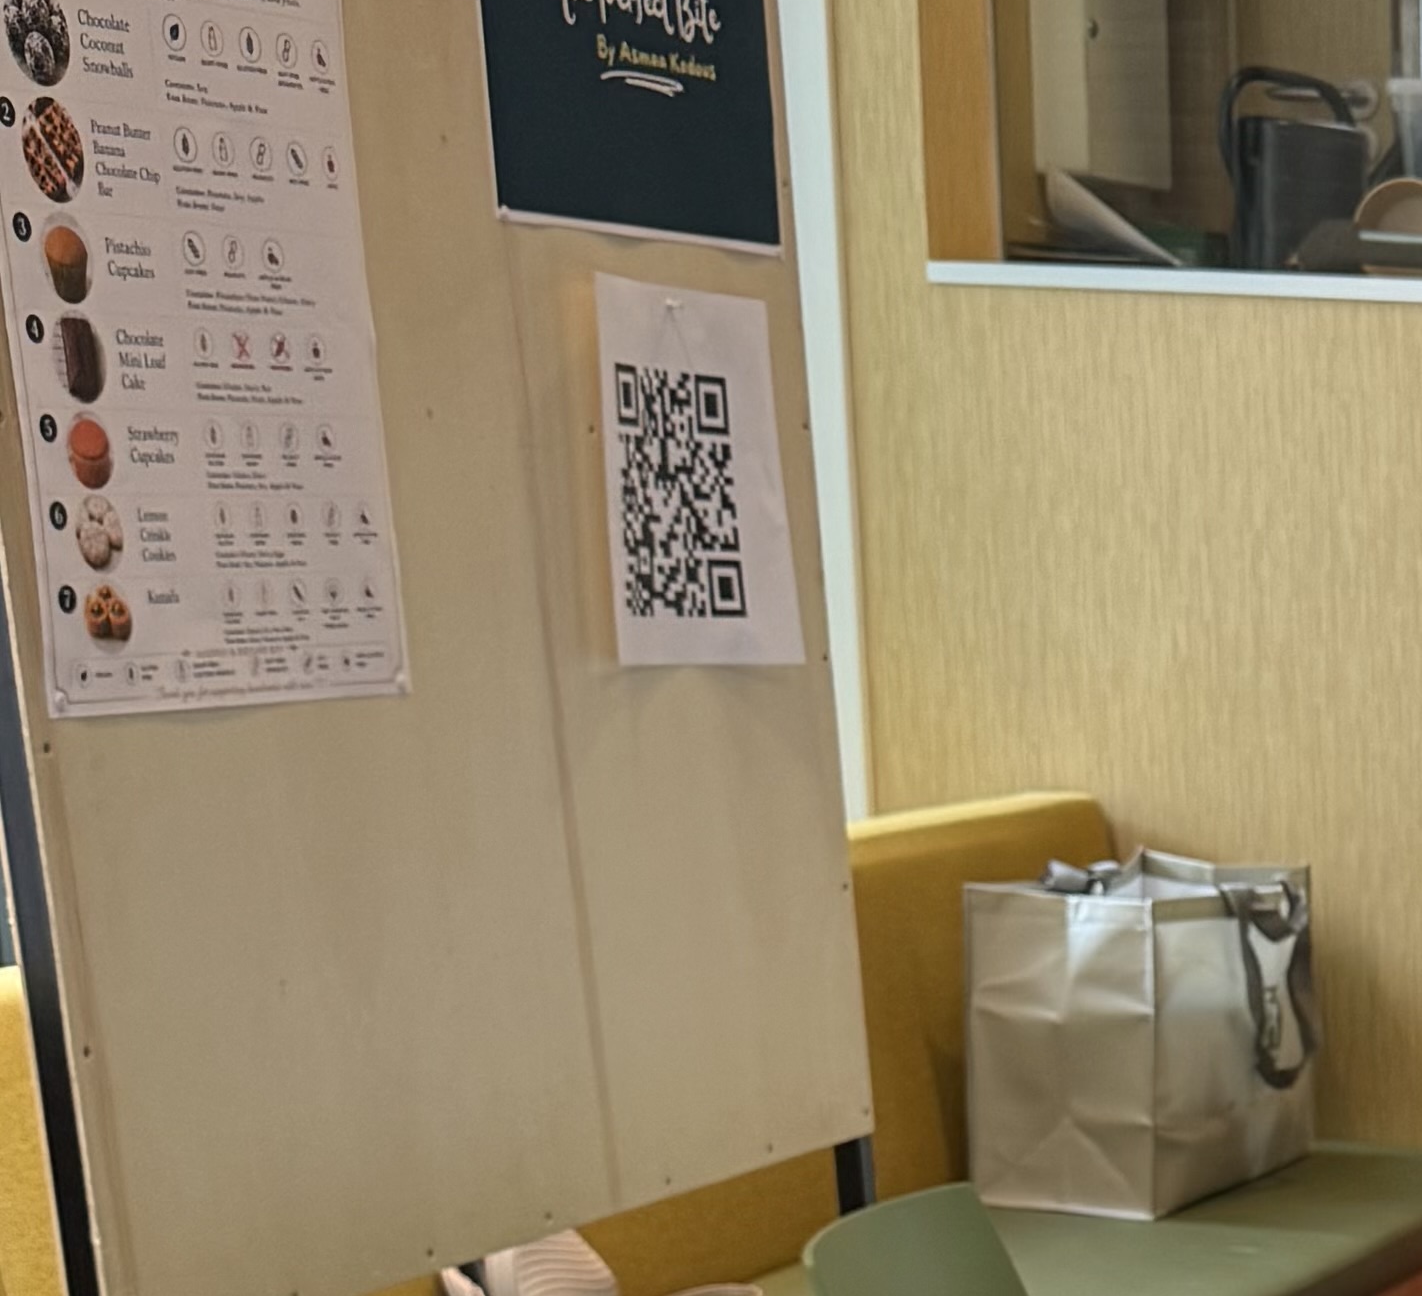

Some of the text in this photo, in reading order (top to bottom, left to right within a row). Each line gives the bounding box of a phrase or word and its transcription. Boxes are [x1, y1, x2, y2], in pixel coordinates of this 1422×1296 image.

[78, 9, 130, 33] Chocolate
[80, 33, 125, 55] Coconut
[597, 33, 615, 66] By
[83, 56, 134, 79] Snowballs
[18, 215, 27, 236] 3
[30, 319, 39, 338] 4
[54, 509, 63, 525] 6
[63, 592, 71, 608] 7
